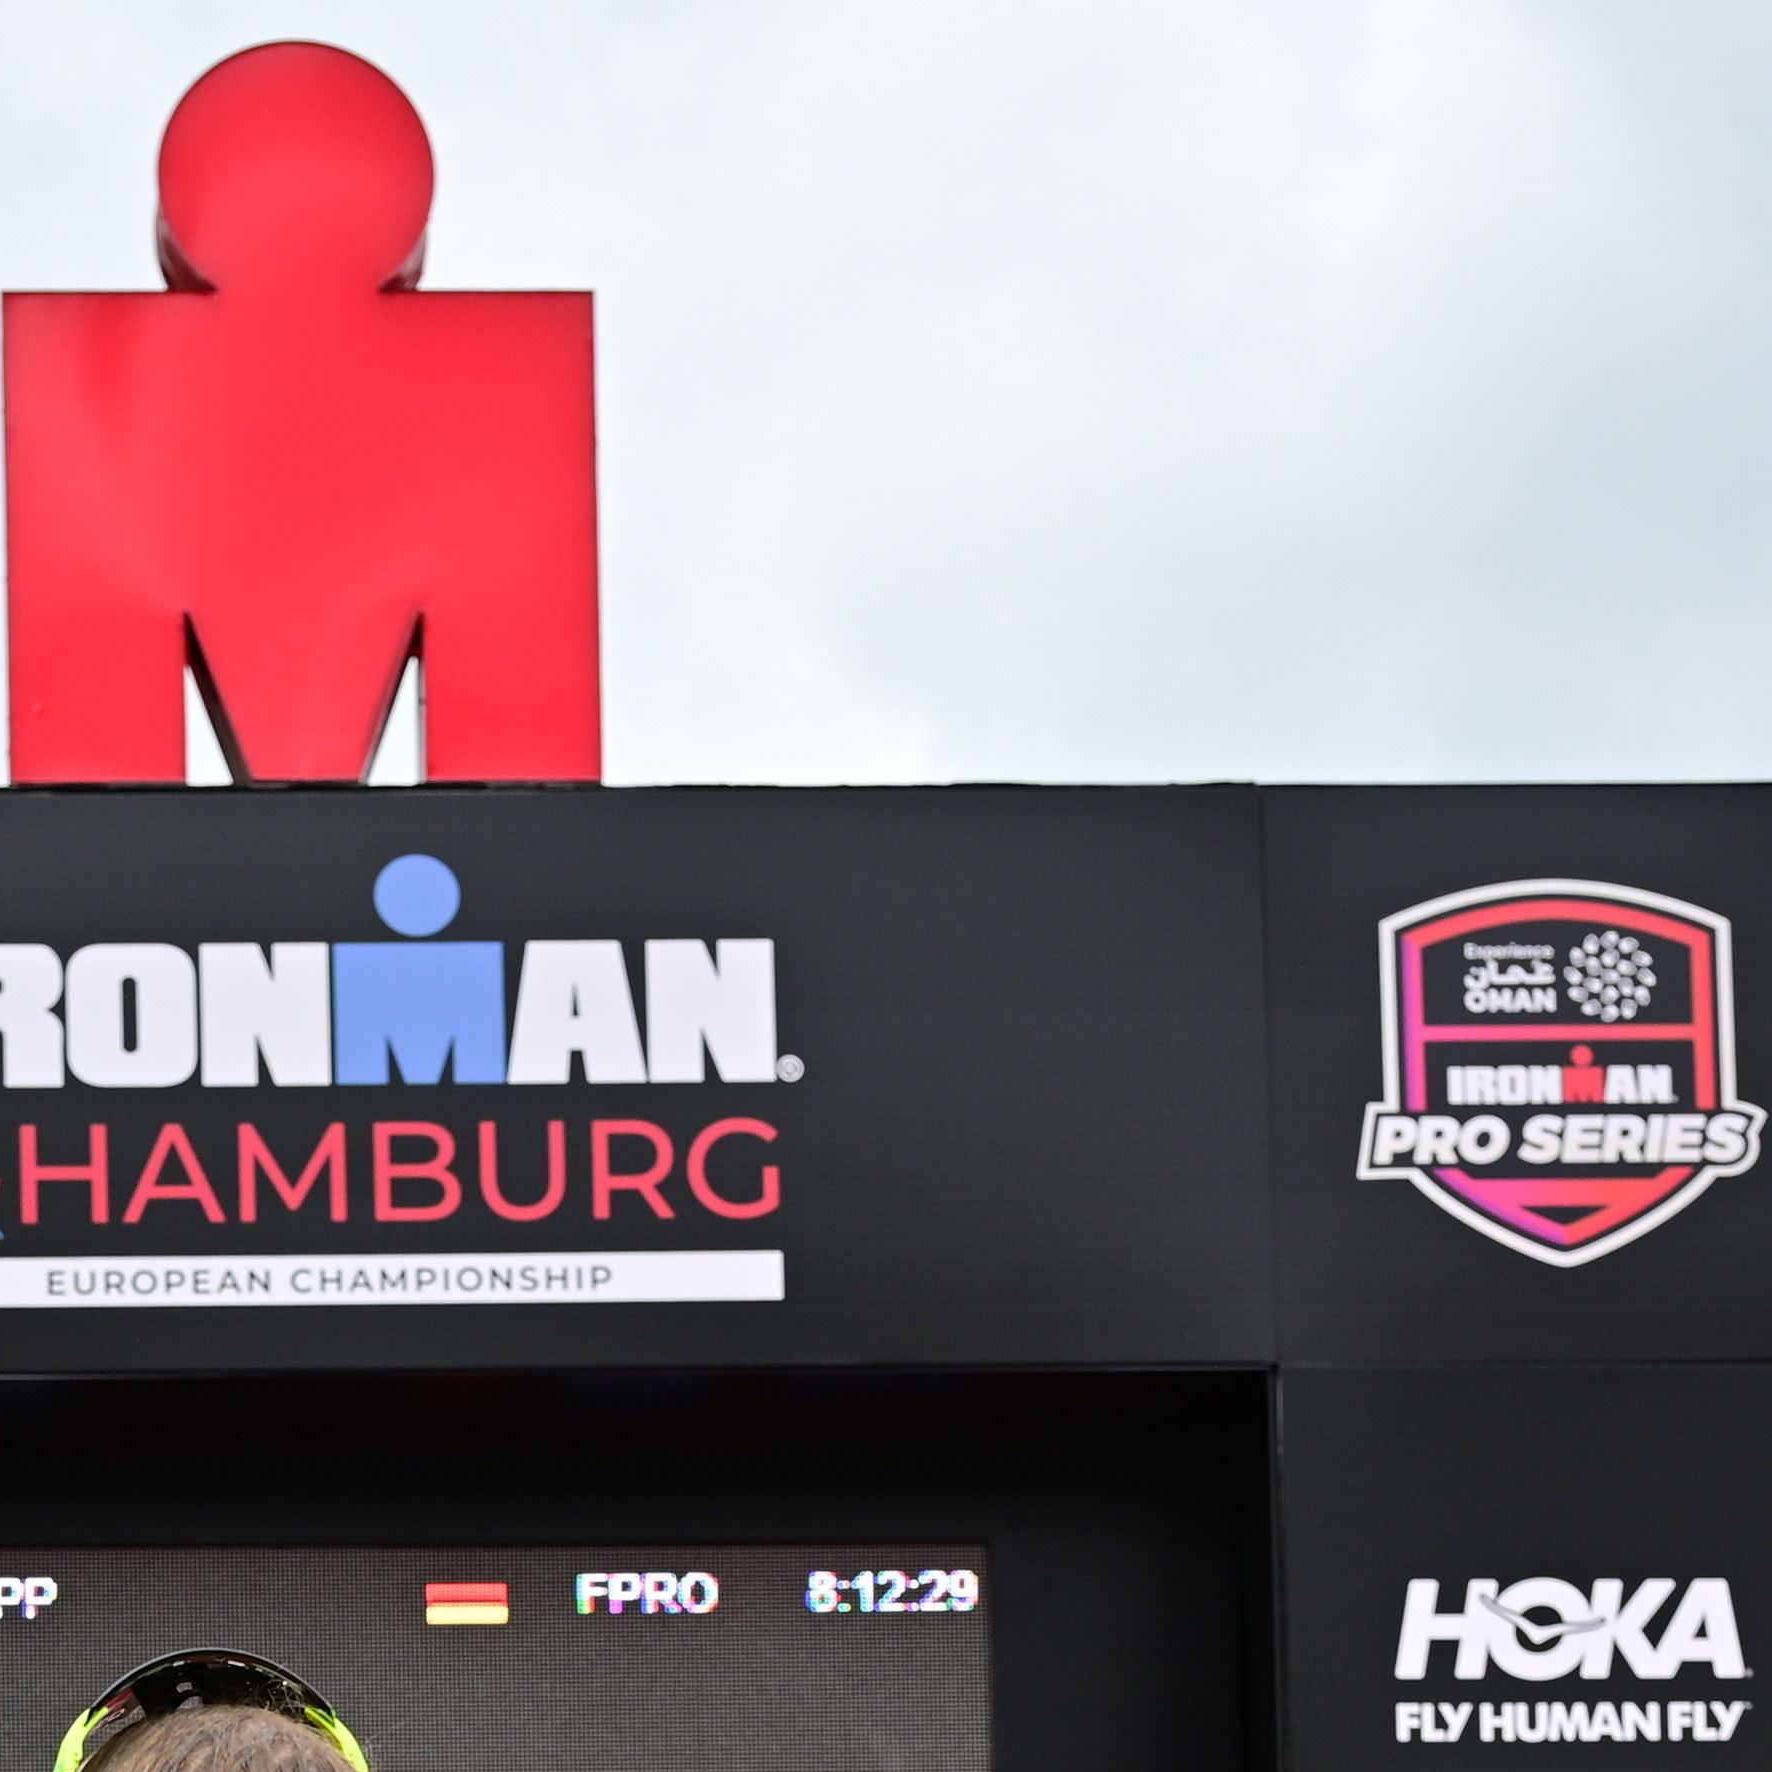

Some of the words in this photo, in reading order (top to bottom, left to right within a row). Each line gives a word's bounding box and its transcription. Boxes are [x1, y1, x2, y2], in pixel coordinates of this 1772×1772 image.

[1463, 943, 1555, 962] Experience
[1463, 988, 1557, 1014] OMAN
[1447, 1065, 1675, 1105] IRONMAN
[1373, 1114, 1510, 1165] PRO
[1517, 1113, 1751, 1164] SERIES
[19, 1116, 782, 1225] HAMBURG
[47, 1268, 274, 1296] EUROPEAN
[291, 1264, 613, 1293] CHAMPIONSHIP
[576, 1572, 718, 1614] FPRO
[805, 1569, 979, 1613] 8:12:29
[1394, 1577, 1746, 1681] HOKA
[1395, 1701, 1474, 1743] FLY
[1479, 1701, 1661, 1742] HUMAN
[1667, 1701, 1745, 1742] FLY
